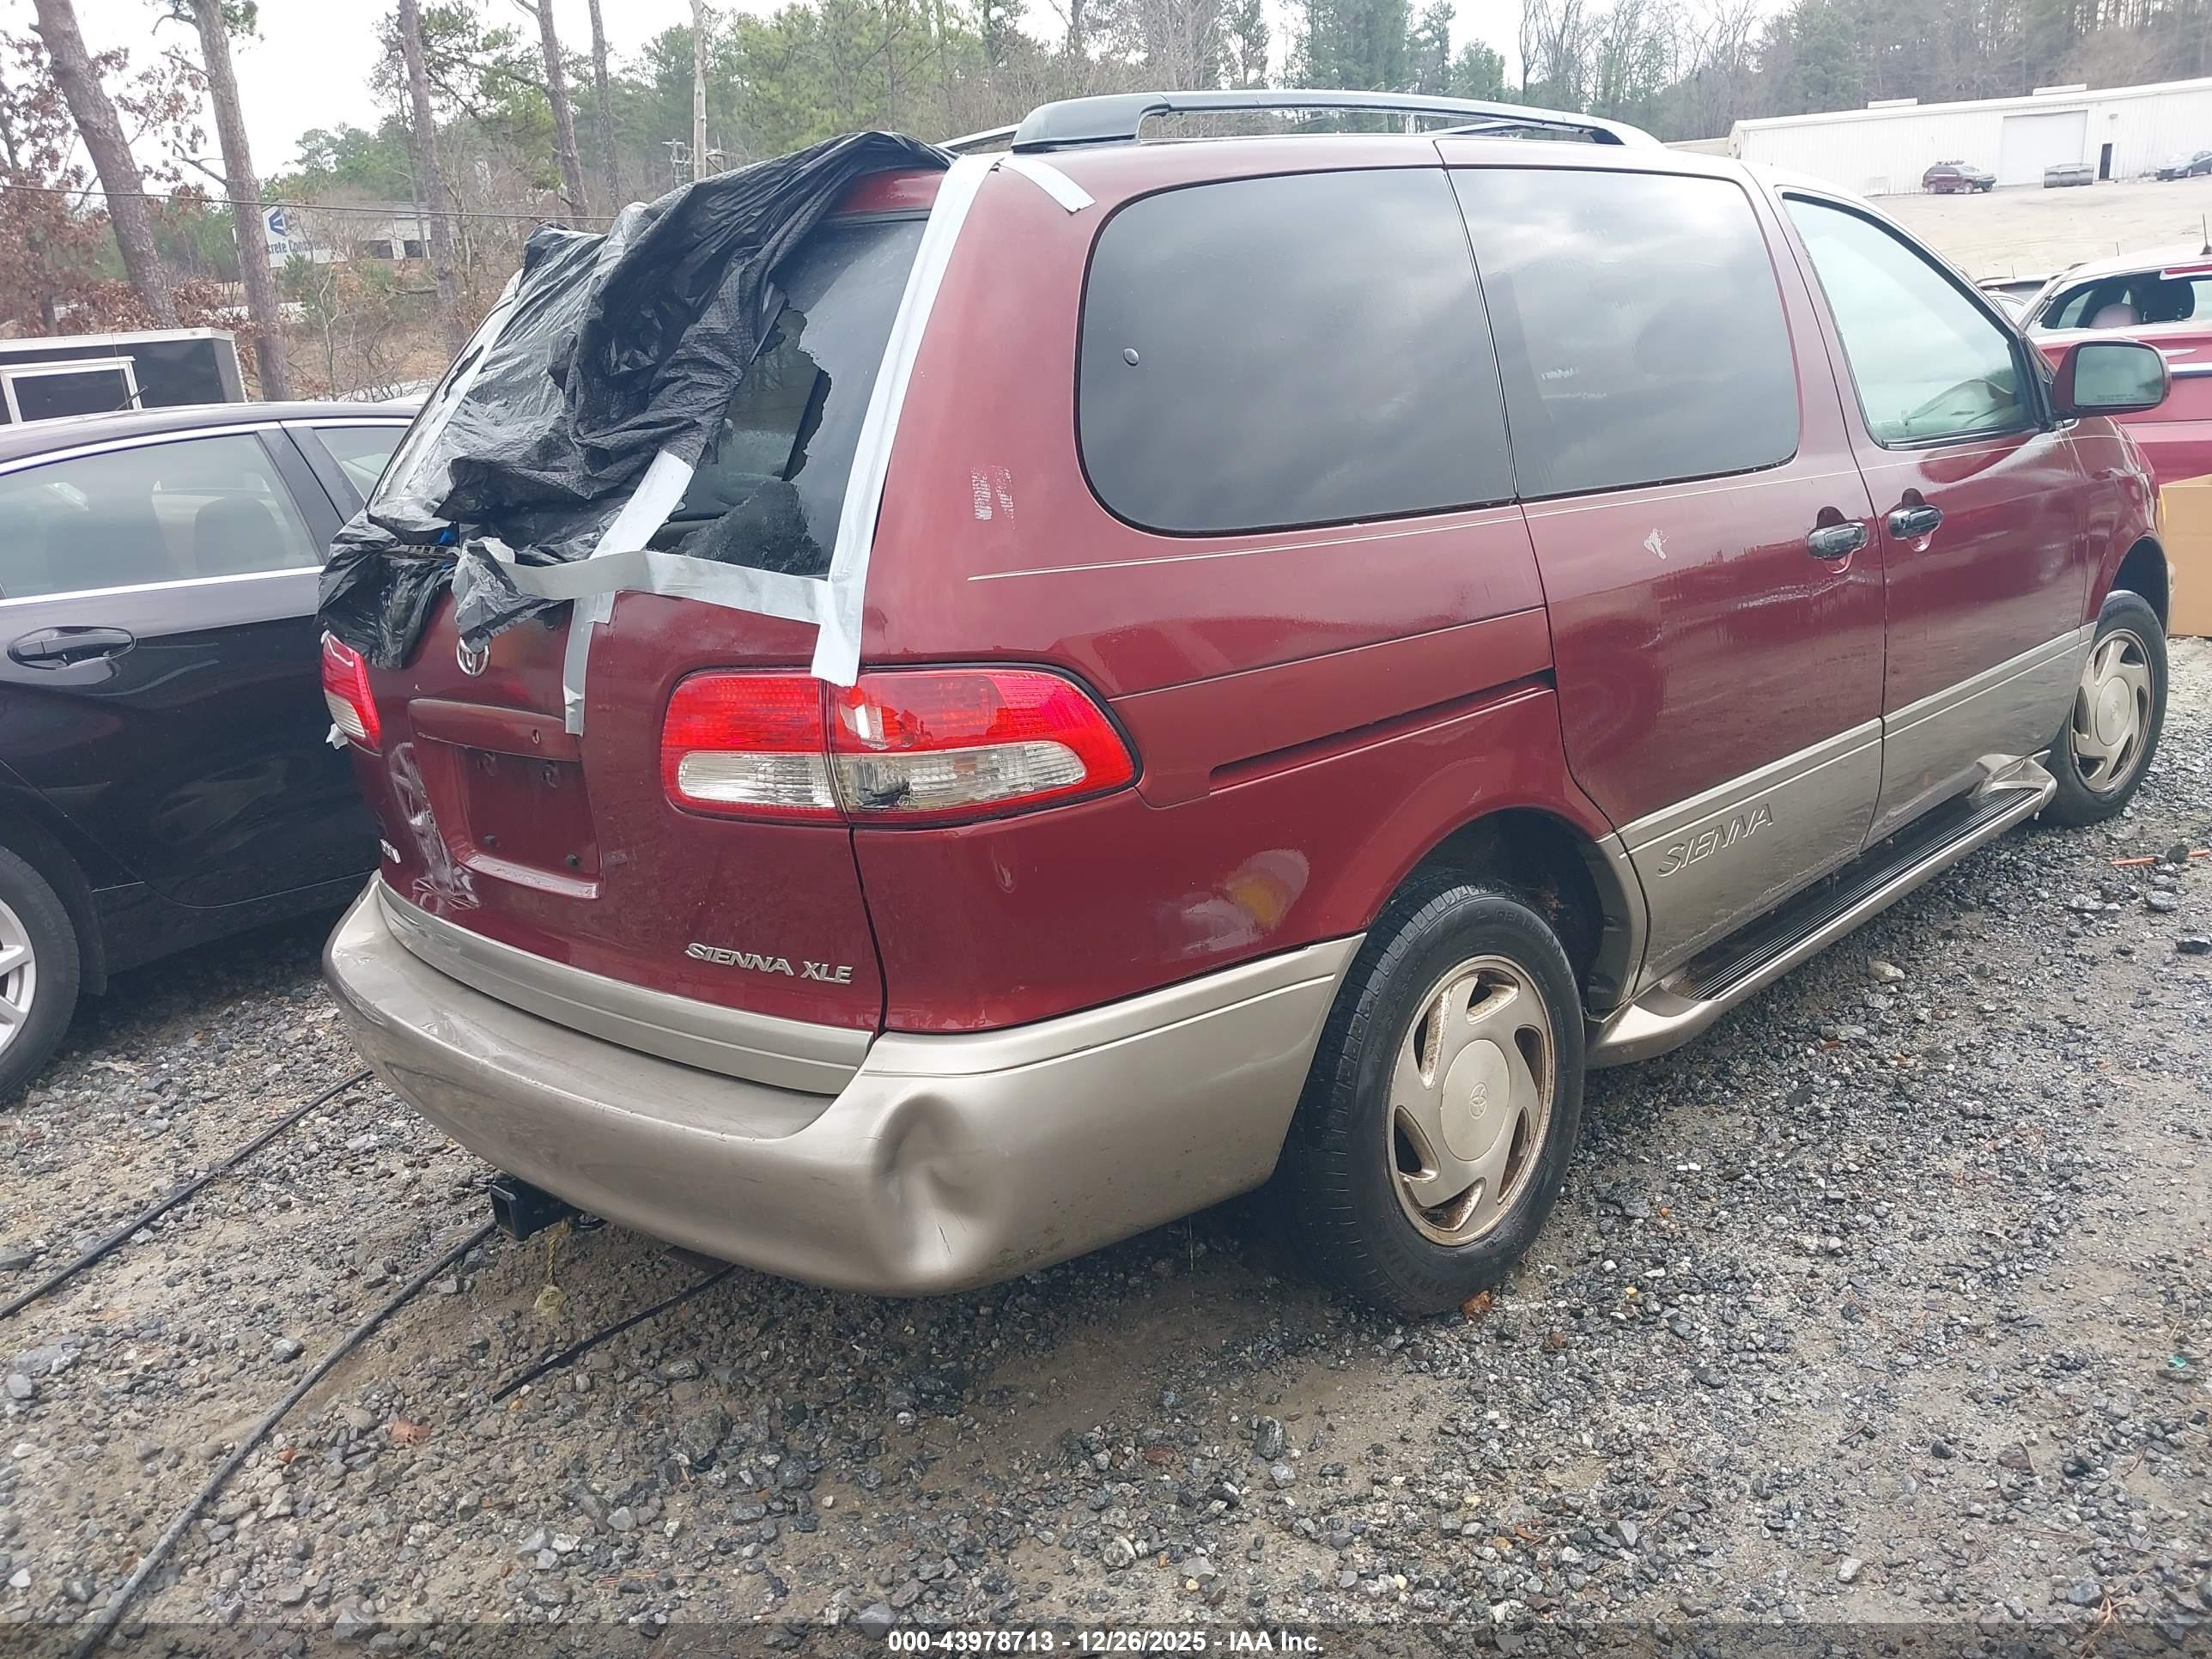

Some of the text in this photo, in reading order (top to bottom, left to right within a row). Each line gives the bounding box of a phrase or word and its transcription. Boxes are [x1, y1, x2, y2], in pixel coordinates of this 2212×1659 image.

[268, 241, 288, 255] rete
[1656, 803, 1773, 878] SIENNA
[684, 942, 854, 985] SIENNA XLE
